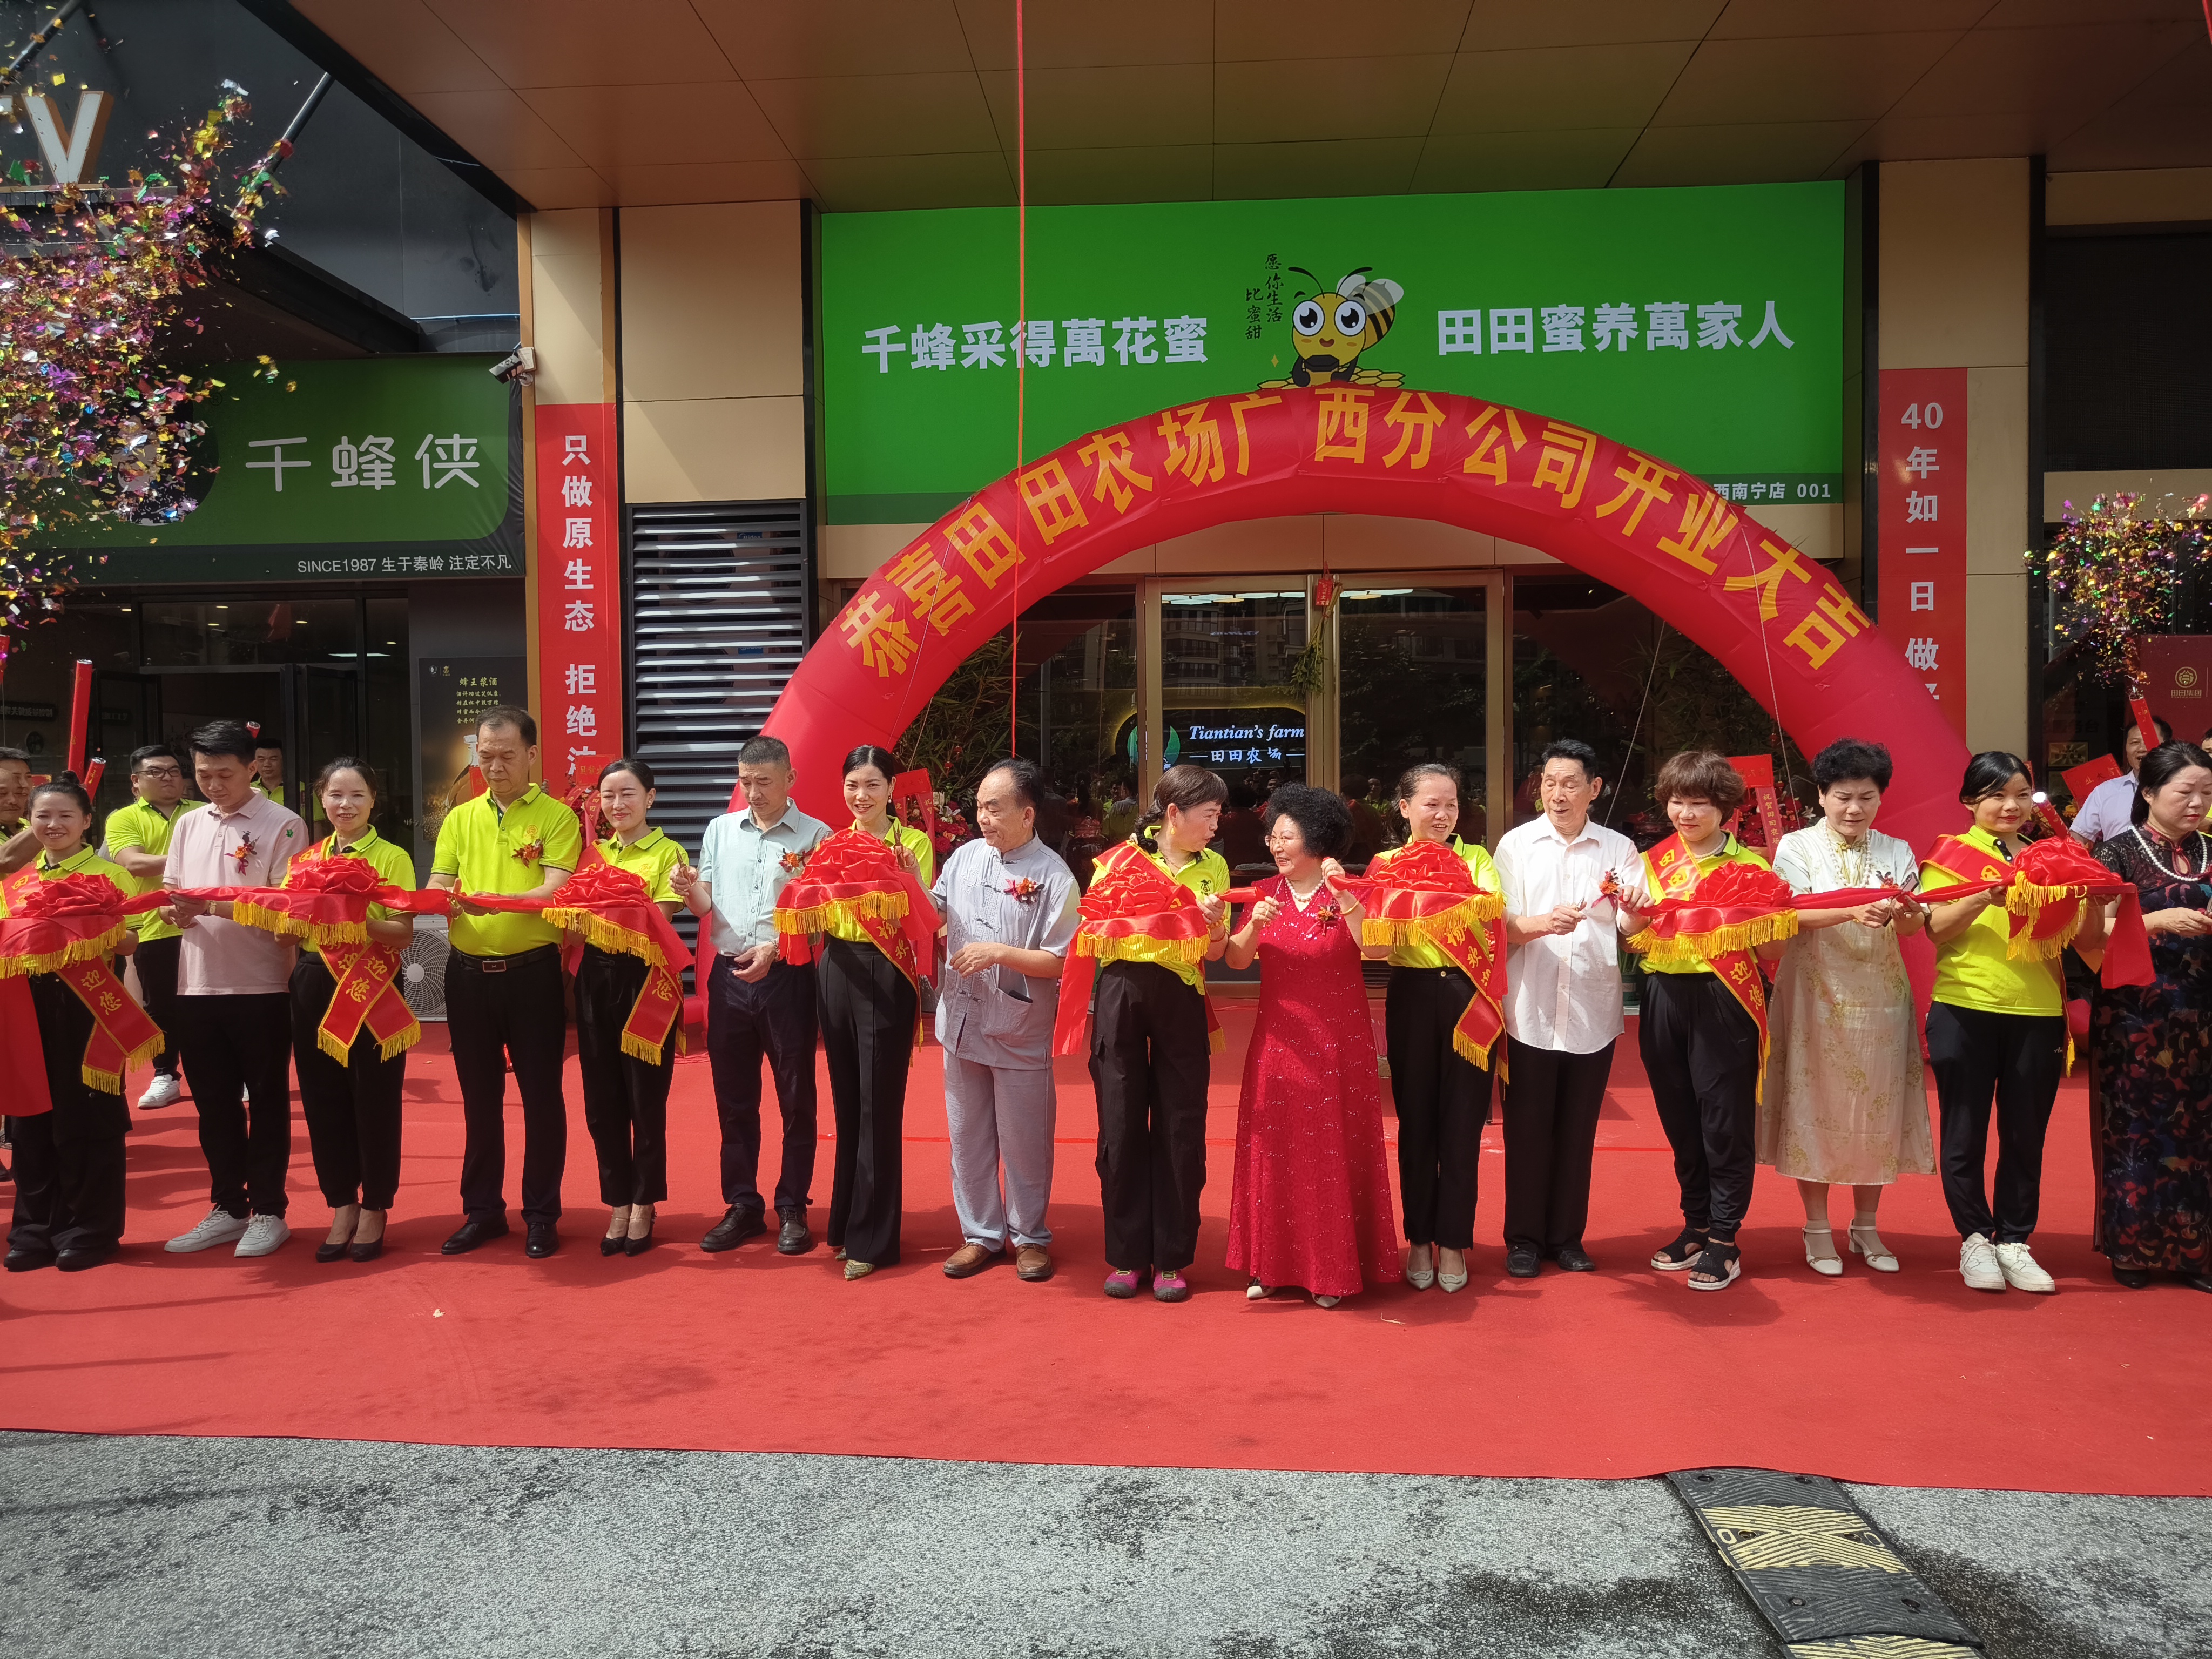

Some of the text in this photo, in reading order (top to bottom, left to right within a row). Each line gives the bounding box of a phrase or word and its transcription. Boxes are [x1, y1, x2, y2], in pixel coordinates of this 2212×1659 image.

[1245, 288, 1264, 340] 比蜜甜
[1265, 253, 1284, 323] 愿你生活
[862, 315, 1209, 373] 千蜂采得萬花蜜
[1437, 300, 1795, 356] 田田蜜养萬家人
[245, 433, 480, 493] 千蜂侠
[1713, 482, 1831, 500] 西南宁店 001
[561, 435, 595, 632] 只做原生态
[839, 386, 1872, 678] 恭喜田田农场广西分公司开业大吉
[298, 554, 512, 573] SINCE1987 生于秦岭 注定不凡
[460, 677, 498, 687] 蜂王浆酒
[1189, 724, 1305, 741] Tiantian's farm
[1211, 747, 1282, 765] 田田农场
[66, 960, 122, 1016] 迎您
[1715, 950, 1763, 1011] 迎您
